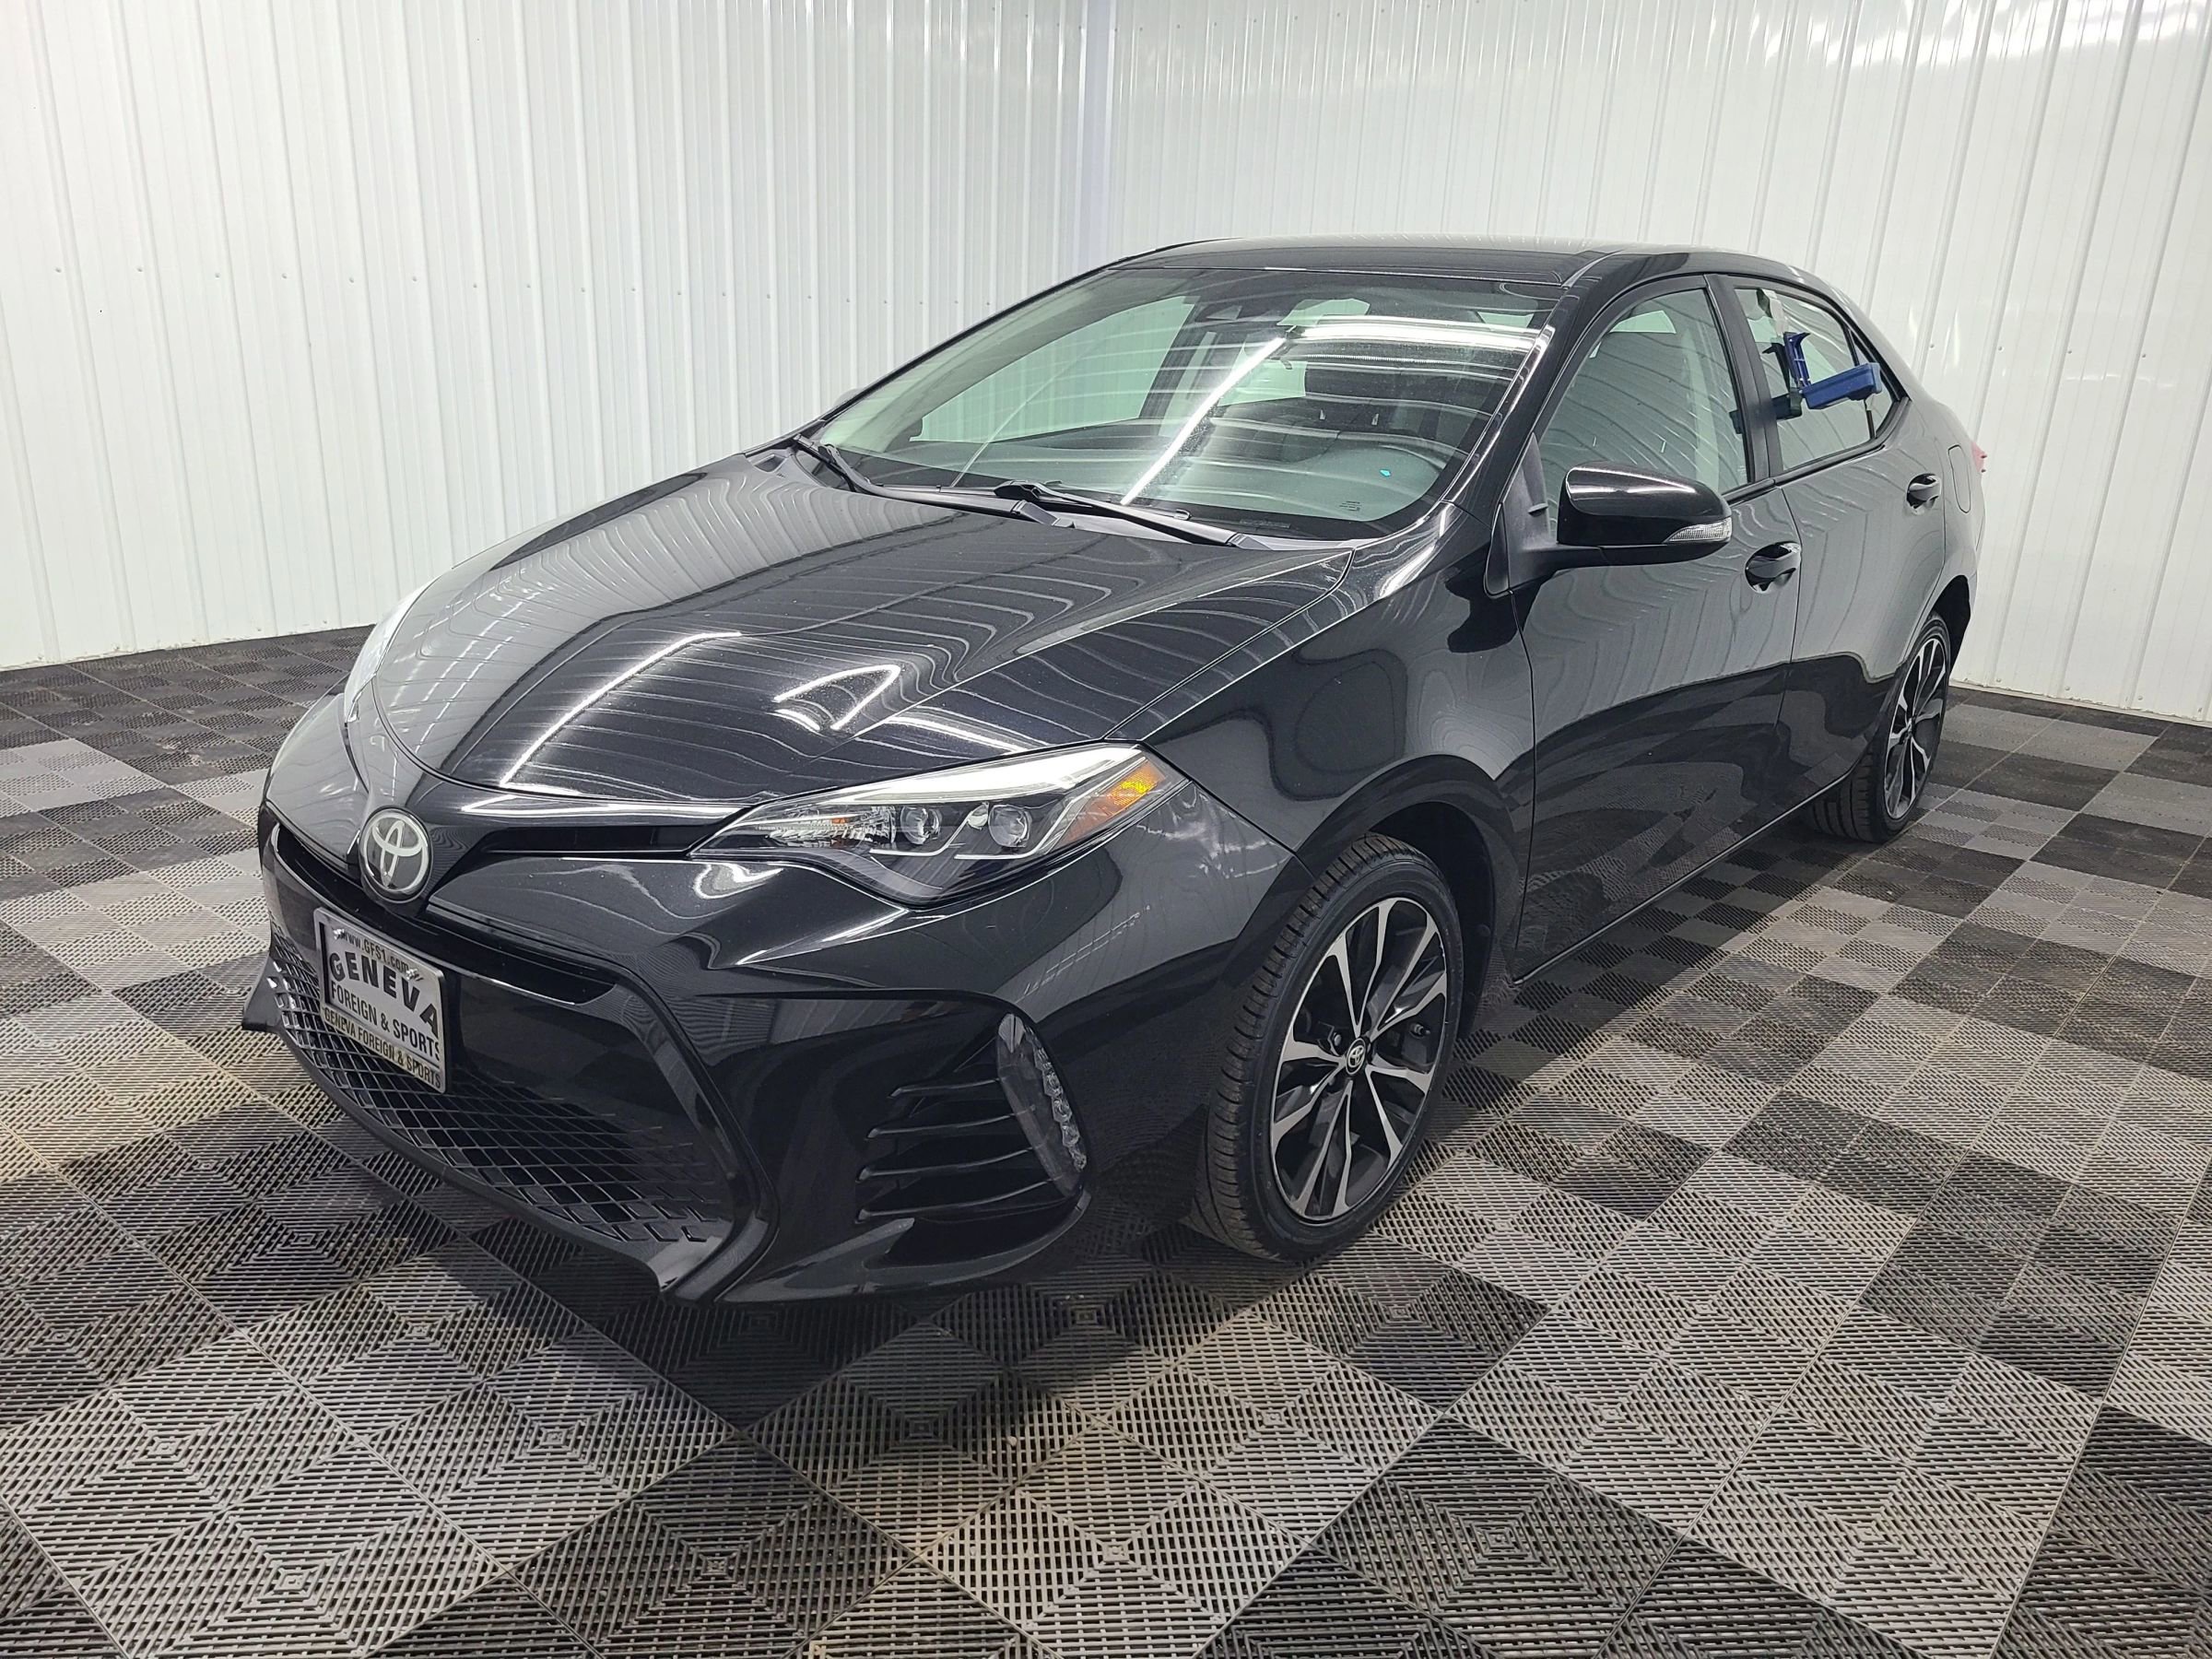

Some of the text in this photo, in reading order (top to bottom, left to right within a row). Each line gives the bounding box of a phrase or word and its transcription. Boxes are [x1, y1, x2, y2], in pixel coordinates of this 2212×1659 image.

[329, 952, 438, 1039] GENEVA
[331, 980, 440, 1061] FOREIGN & SPORTS
[324, 1007, 441, 1088] GENEVA FOREIGN & SPORTS
